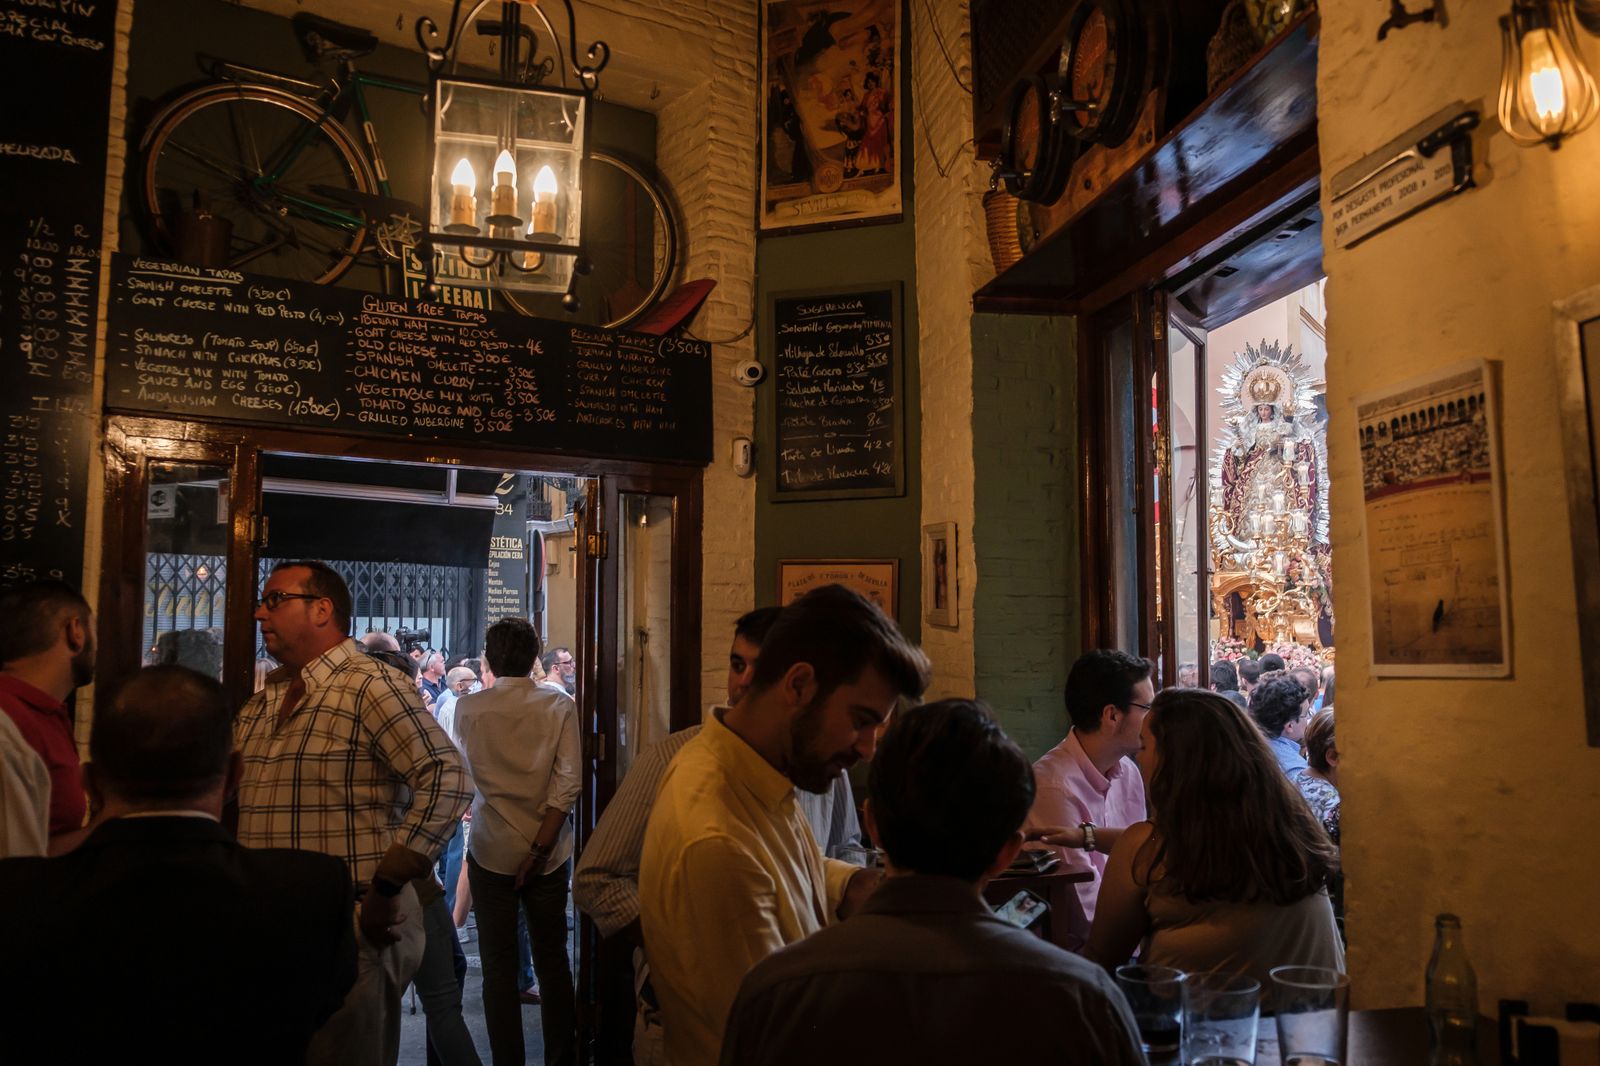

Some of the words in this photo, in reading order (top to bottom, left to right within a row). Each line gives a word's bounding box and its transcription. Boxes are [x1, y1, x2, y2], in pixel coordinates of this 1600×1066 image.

[132, 257, 200, 277] VEGETARIAN
[205, 268, 245, 282] TAPAS
[128, 277, 174, 292] SPANISH
[180, 284, 233, 298] OMELETTE
[132, 292, 166, 307] GOAT
[174, 296, 216, 311] CHEESE
[224, 302, 250, 314] WITH
[254, 304, 275, 317] RED
[279, 304, 306, 320] PESTO
[362, 294, 408, 314] GLUTEN
[416, 302, 445, 316] FREE
[452, 308, 488, 324] TAPAS
[134, 328, 194, 346] SALMOREJO
[202, 332, 246, 350] (TOMATO
[250, 337, 280, 352] SOUP)
[355, 327, 386, 338] GOAT
[390, 329, 428, 342] CHEESE
[432, 334, 455, 345] WITH
[618, 334, 656, 348] TAPAS
[192, 349, 218, 362] WITH
[358, 338, 384, 350] OLD
[389, 340, 438, 359] CHEESE
[616, 350, 656, 364] BURRITO
[134, 358, 190, 378] VEGETABLE
[194, 366, 213, 380] MIX
[222, 368, 248, 380] WITH
[254, 370, 289, 382] TOMATO
[356, 351, 414, 368] SPANISH
[427, 360, 477, 375] OMELETTE
[138, 374, 178, 388] SAUCE
[184, 377, 212, 390] AND
[220, 380, 246, 392] EGG
[354, 365, 422, 384] CHICKEN
[434, 374, 476, 391] CURRY
[137, 385, 218, 406] ANDALUSIAN
[232, 394, 284, 410] CHEESES
[355, 381, 435, 400] VEGETABLE
[440, 390, 464, 404] MIX
[580, 384, 616, 397] SPANISH
[358, 410, 408, 426] GRILLED
[414, 414, 465, 429] AUBERGINE
[359, 397, 406, 411] TOMATO
[412, 400, 452, 416] SAUCE
[457, 406, 483, 418] AND
[490, 408, 514, 420] EGG
[512, 550, 524, 560] CERA
